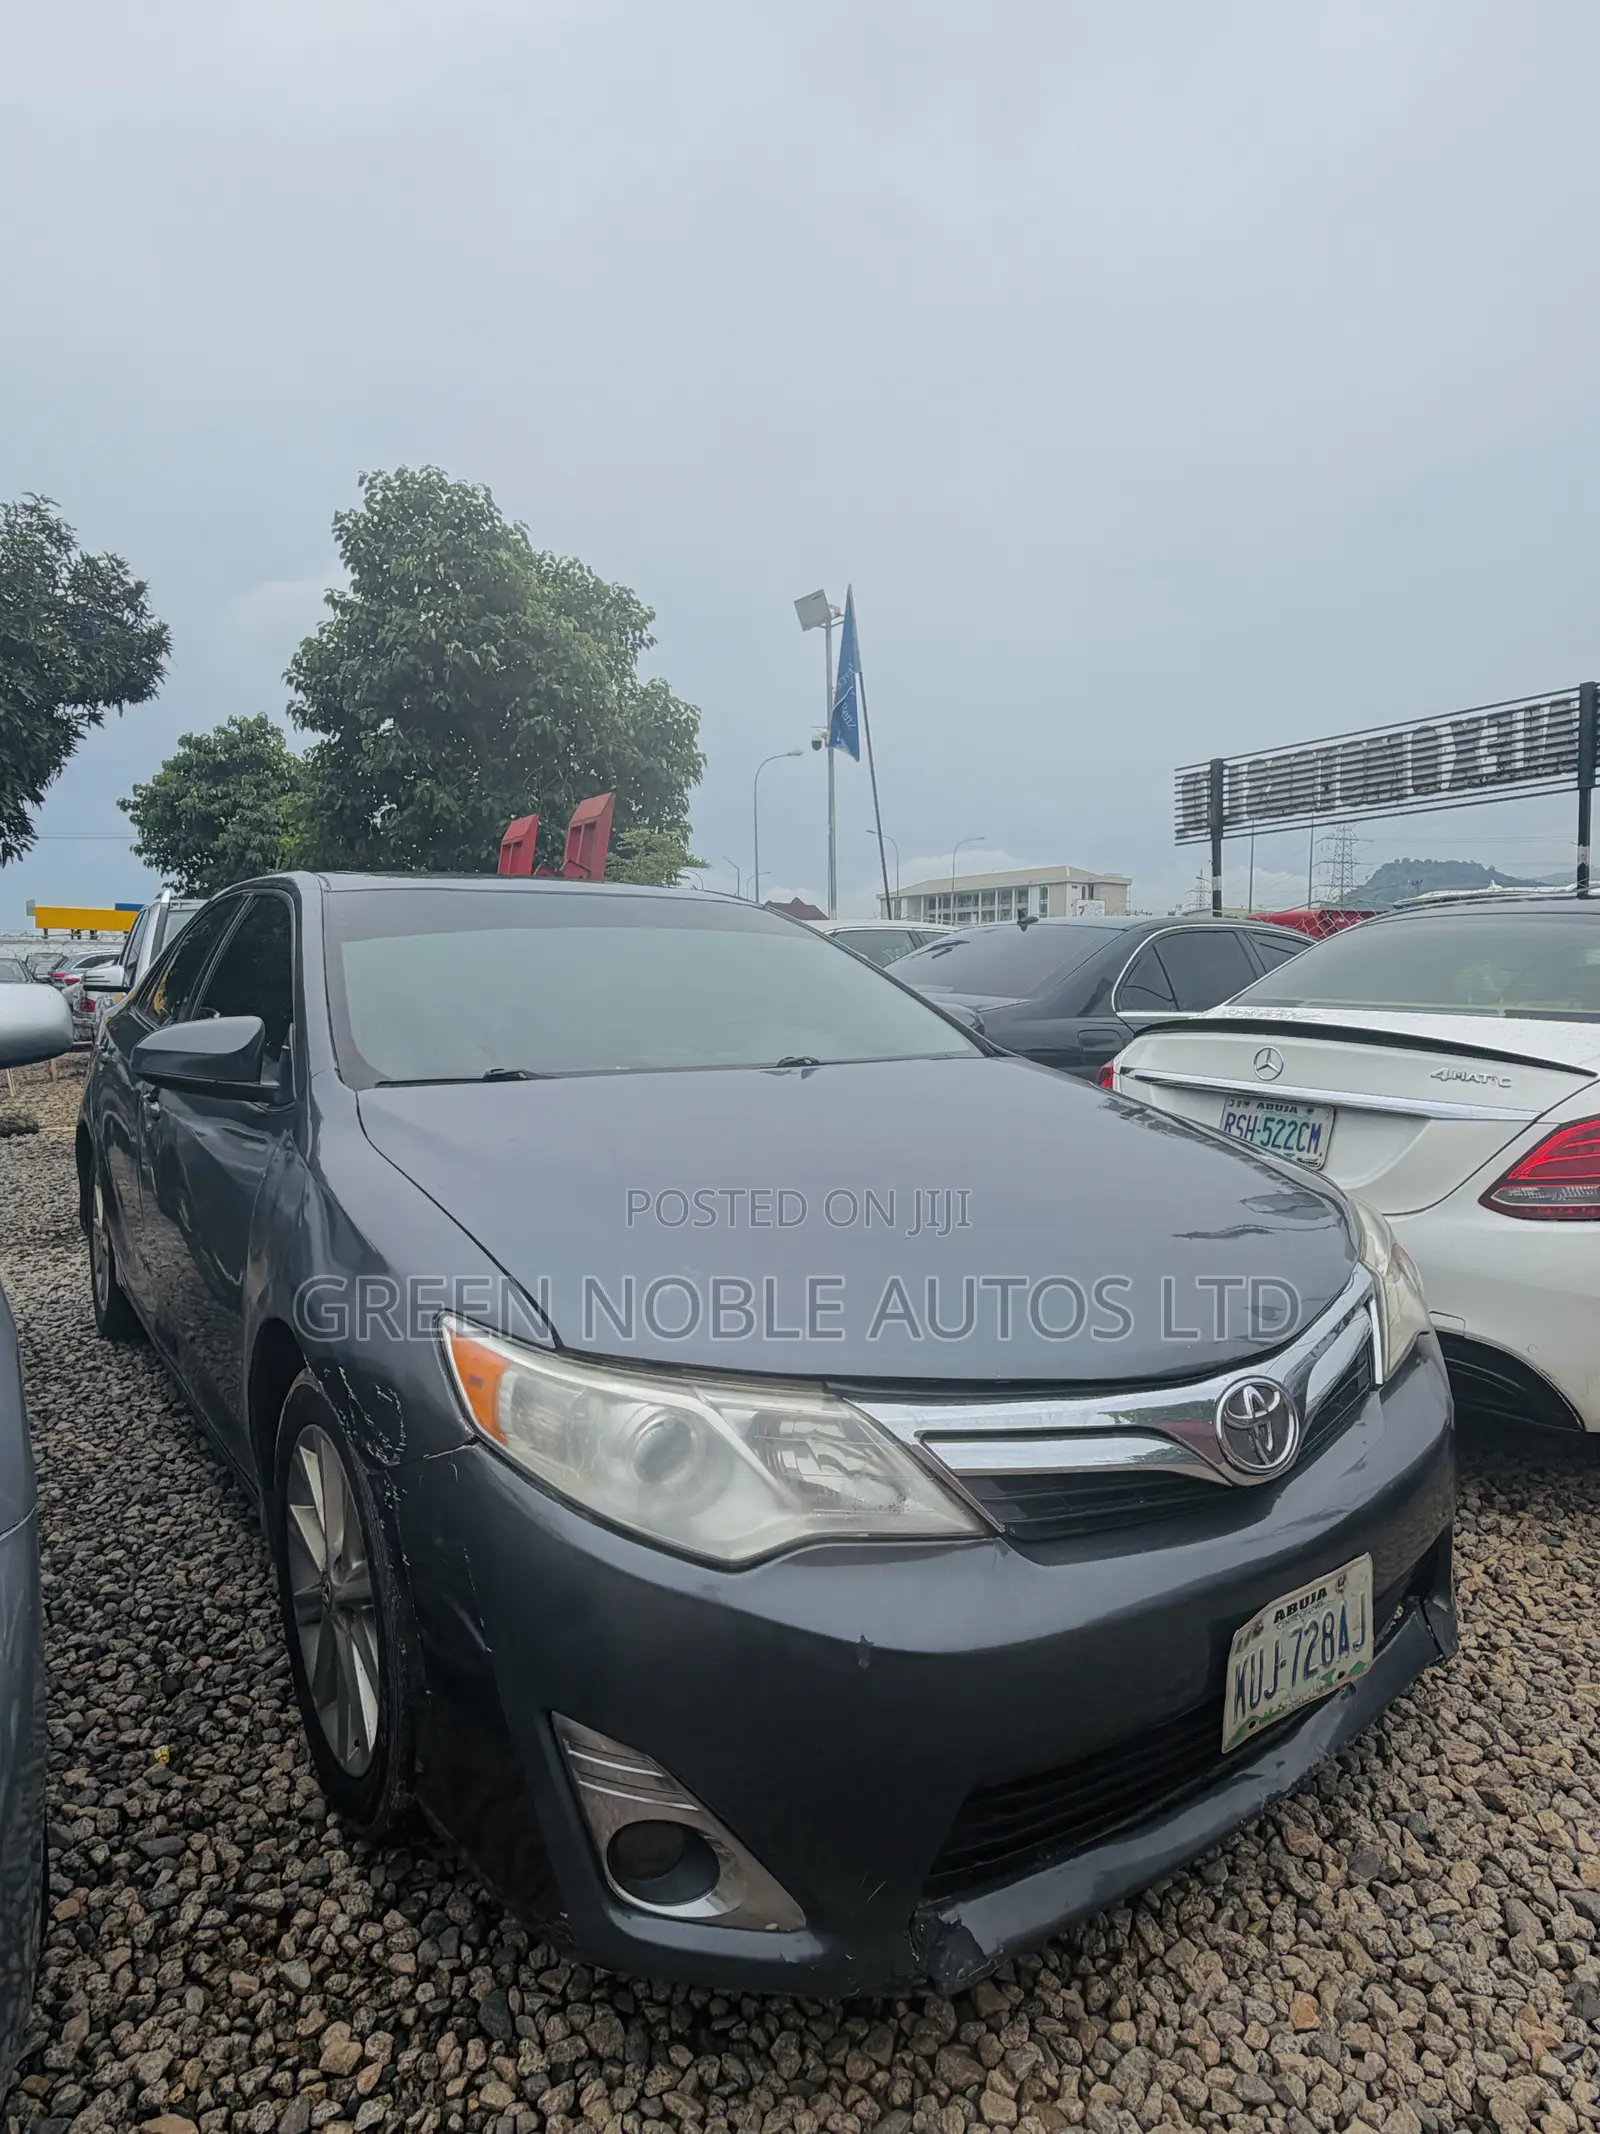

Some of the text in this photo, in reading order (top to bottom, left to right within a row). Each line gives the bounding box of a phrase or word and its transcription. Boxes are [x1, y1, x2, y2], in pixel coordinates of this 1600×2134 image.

[1430, 1067, 1511, 1088] 4MATIC
[1256, 1102, 1298, 1114] ABUJA
[1224, 1112, 1322, 1154] RSH-522CM
[1273, 1587, 1328, 1624] ABUJA
[1233, 1591, 1366, 1725] KUJ-728AJ
